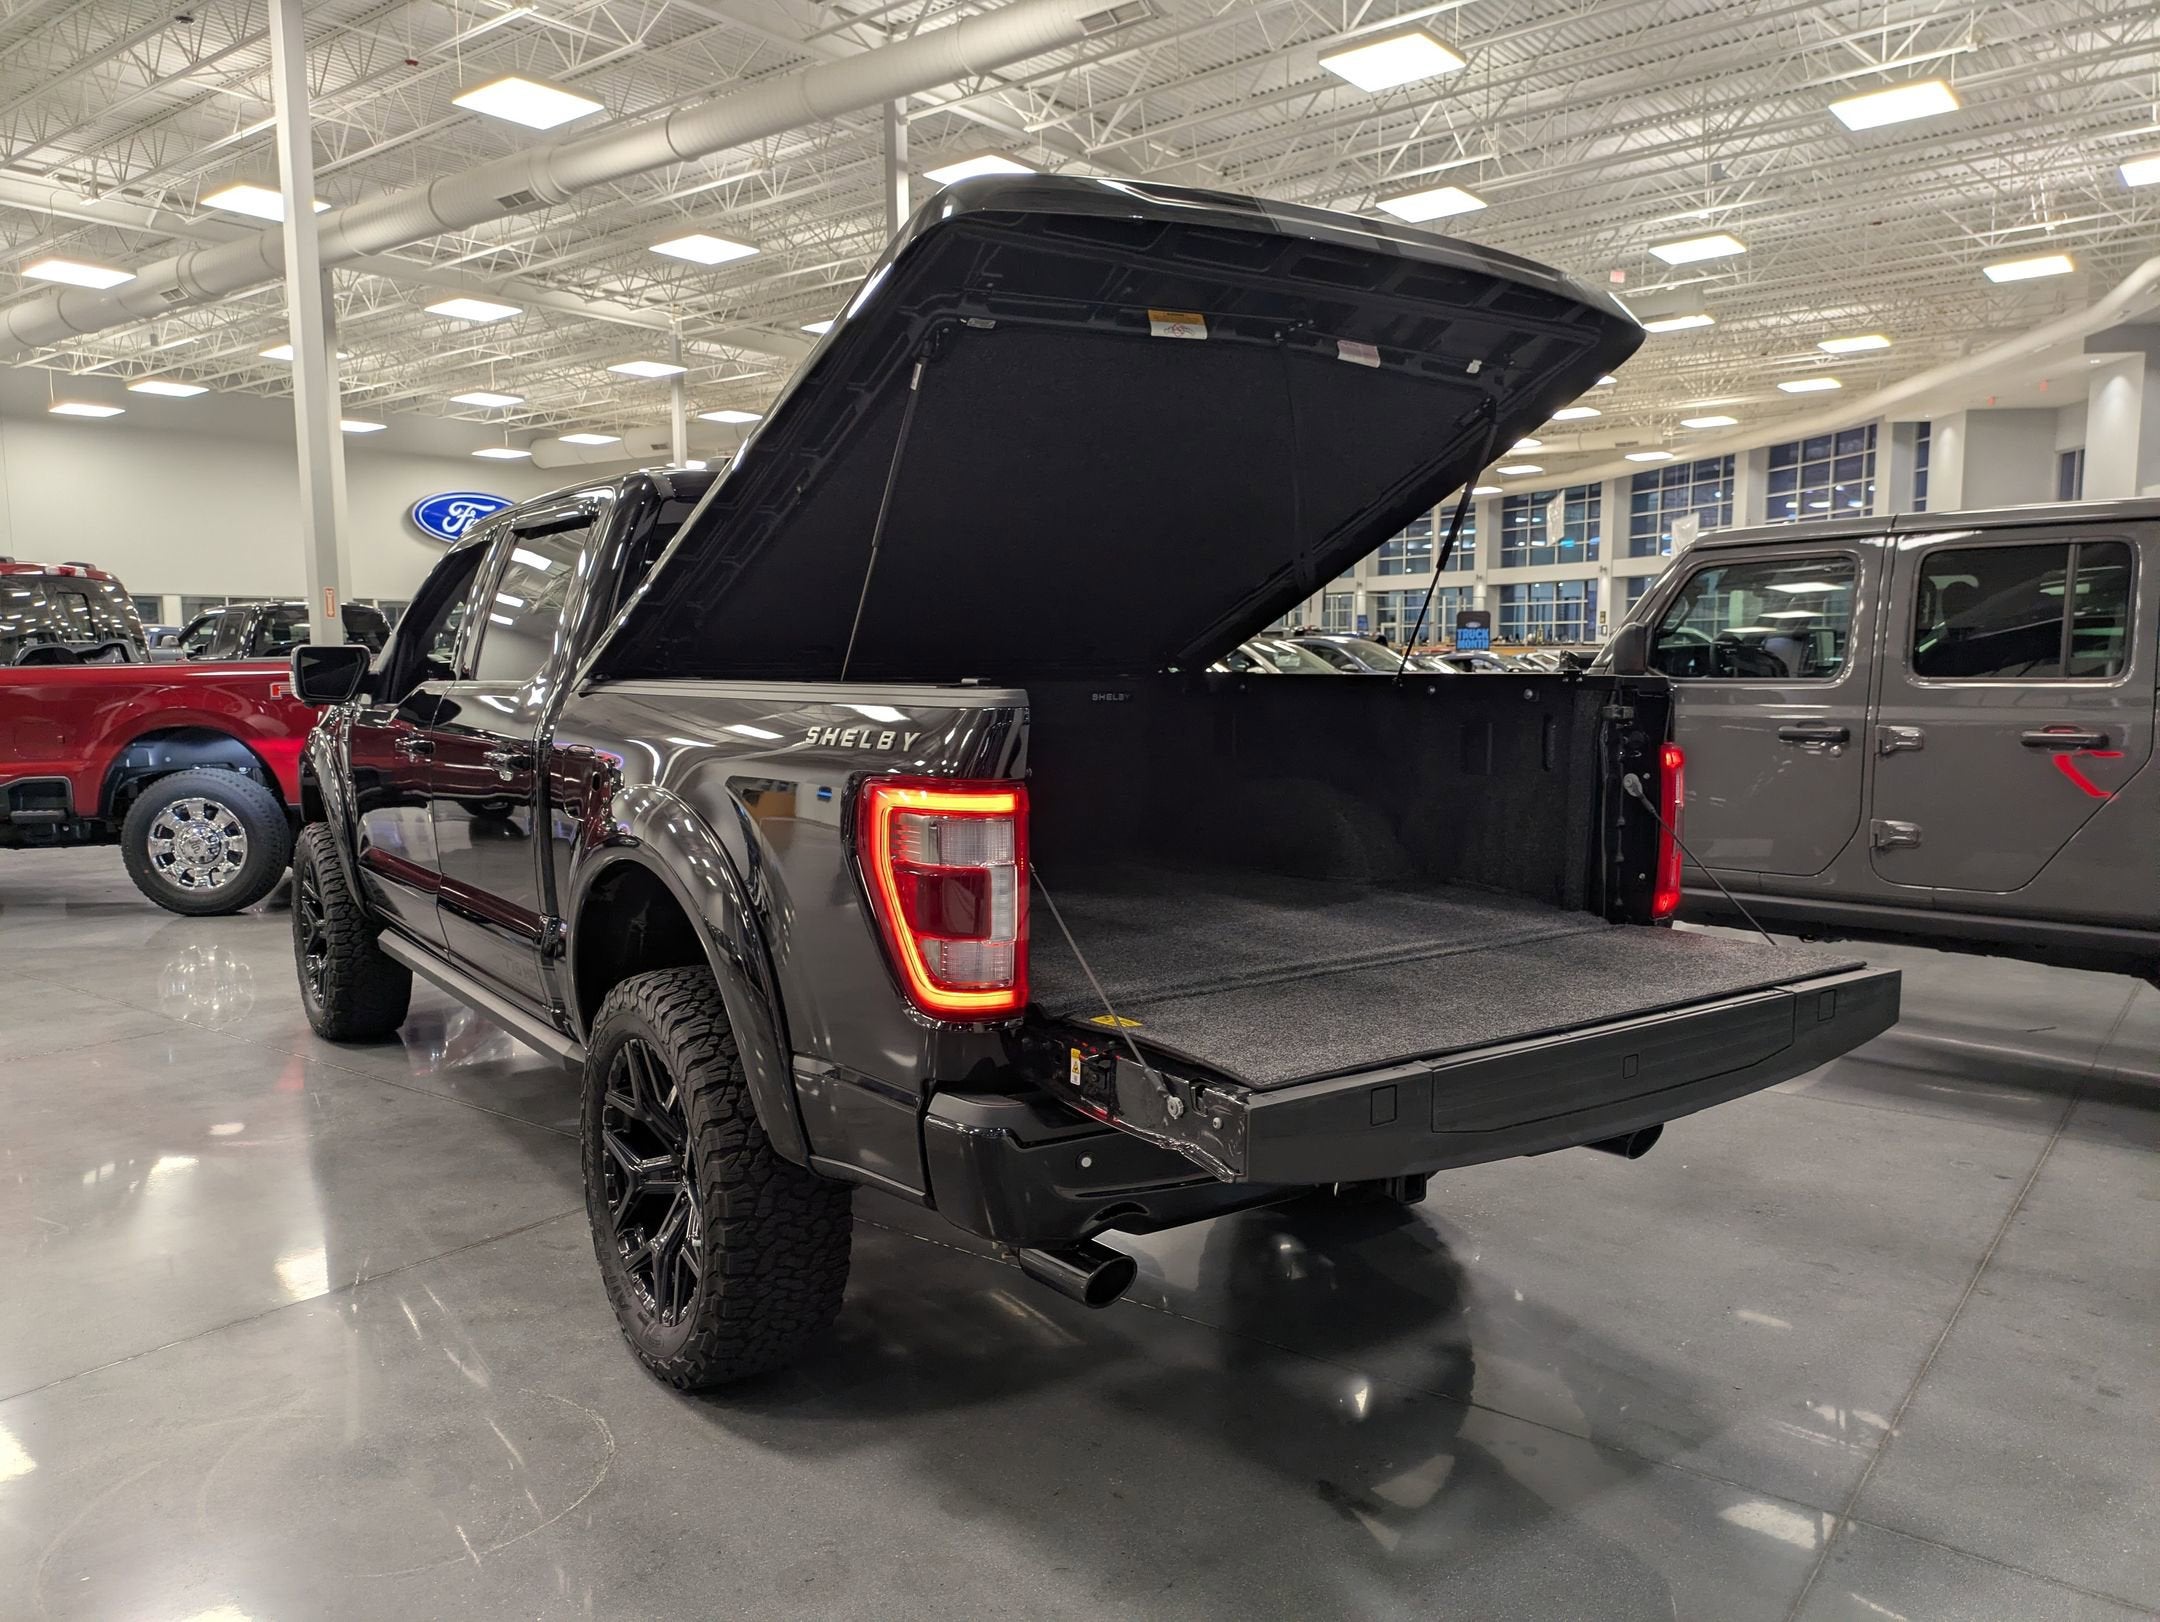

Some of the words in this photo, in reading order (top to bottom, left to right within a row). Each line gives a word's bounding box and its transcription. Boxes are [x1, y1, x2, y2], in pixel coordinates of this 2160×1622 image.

[1456, 628, 1489, 639] TRUCK
[1456, 639, 1489, 650] MONTH
[805, 726, 921, 753] SHELBY
